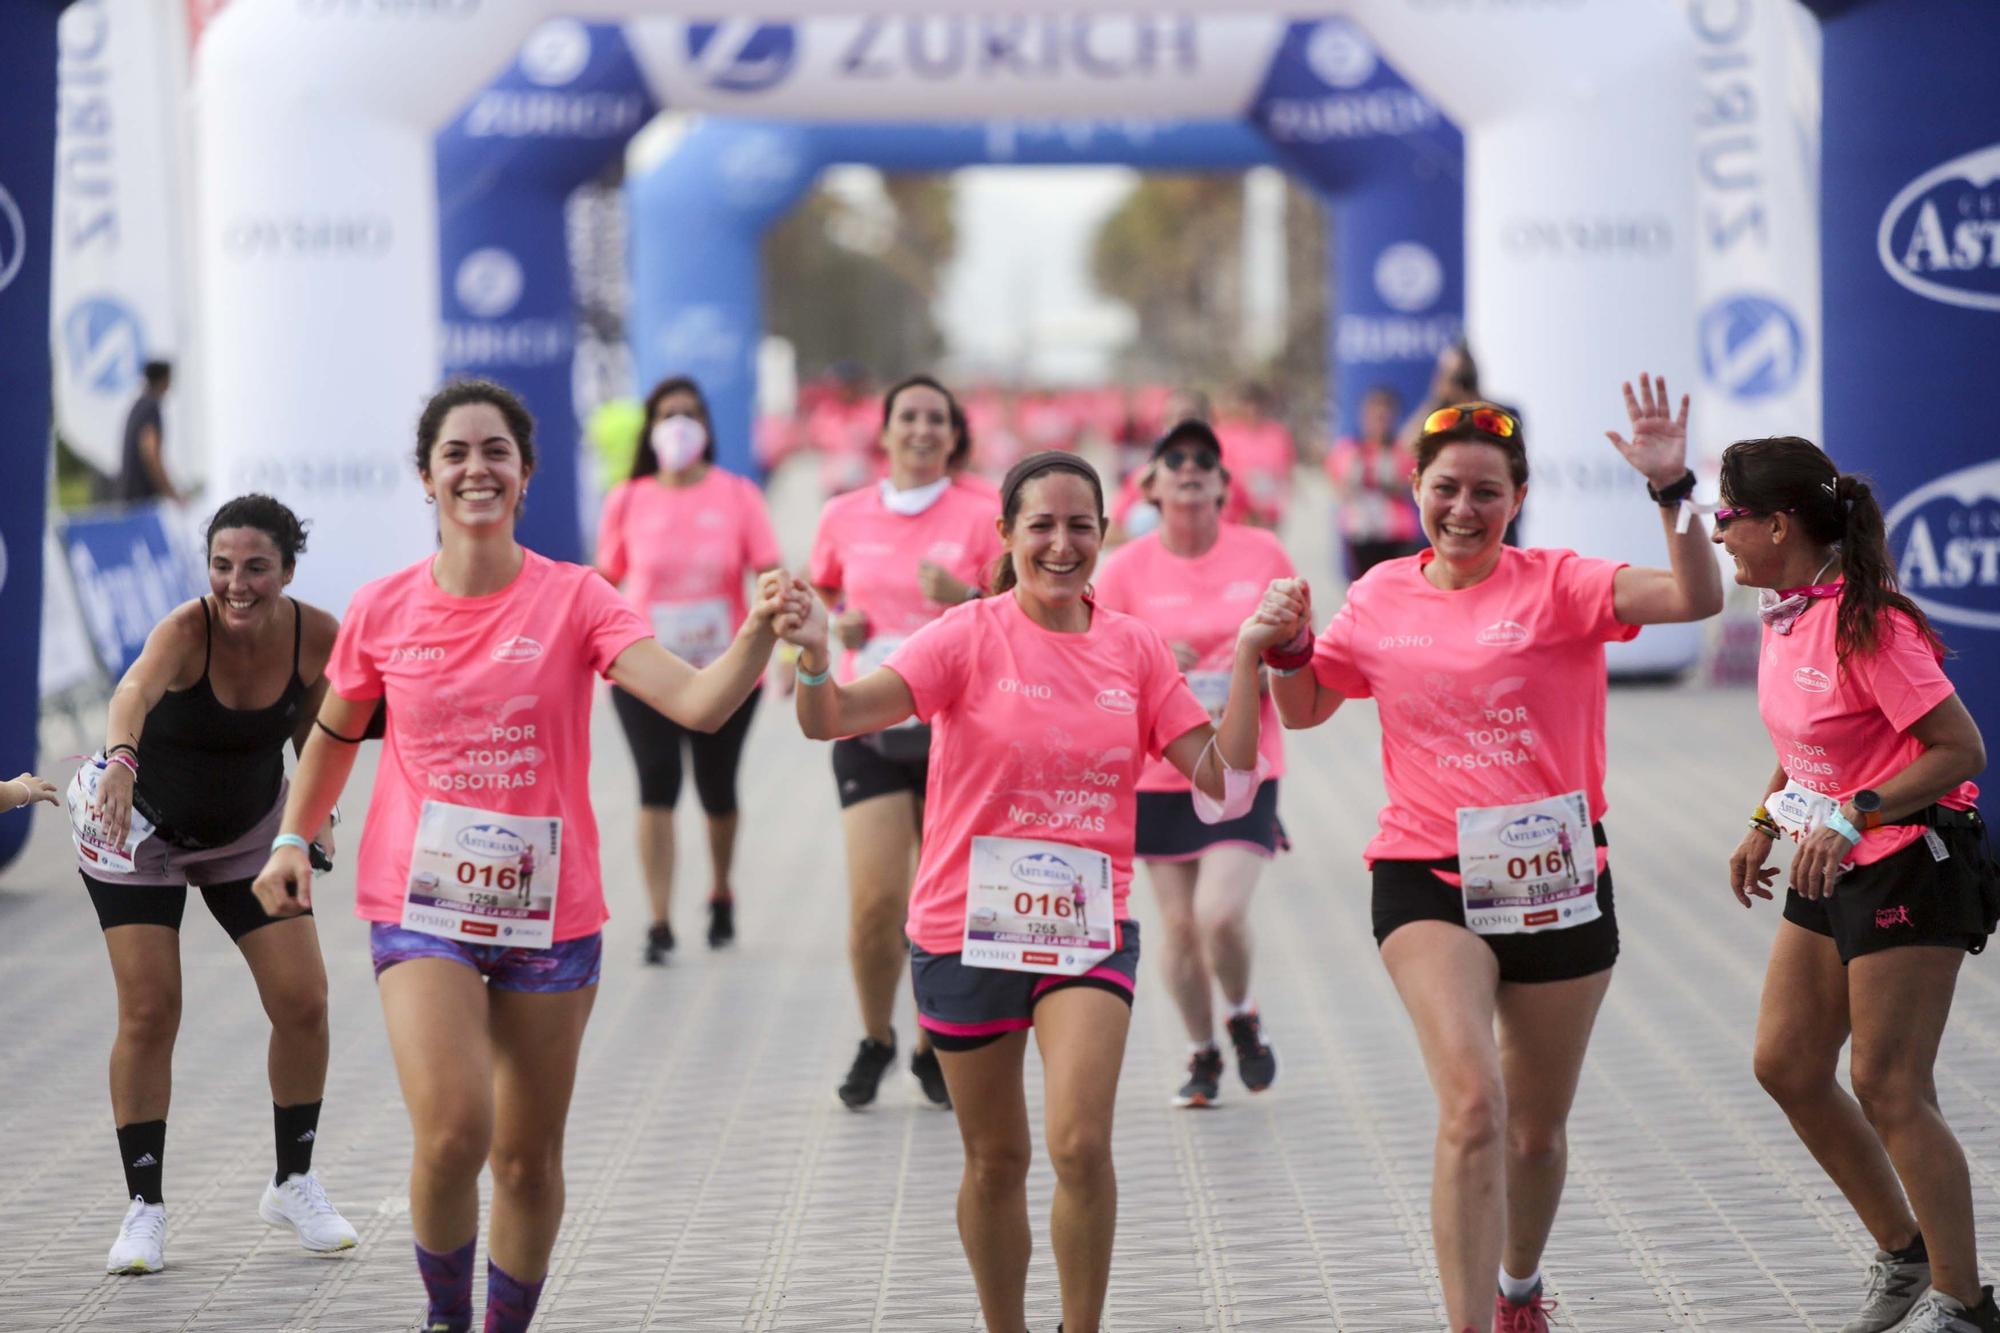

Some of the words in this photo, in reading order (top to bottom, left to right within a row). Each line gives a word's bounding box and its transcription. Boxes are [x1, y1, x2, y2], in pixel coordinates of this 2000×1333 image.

[840, 14, 1198, 79] ZURICH
[1379, 634, 1433, 650] OYSHO
[1484, 706, 1528, 724] POR
[491, 725, 536, 742] POR
[465, 746, 536, 766] TODAS
[1794, 740, 1827, 756] POR
[1786, 755, 1833, 775] TODAS
[428, 770, 536, 790] NOSOTRAS
[1082, 771, 1120, 787] POR
[1055, 789, 1111, 808] TODAS
[1008, 804, 1105, 832] NOSOTRAS
[1506, 850, 1562, 880] 016
[457, 861, 517, 890] 016
[1528, 883, 1550, 896] 510
[468, 892, 499, 906] 1258
[1013, 892, 1072, 918] 016
[487, 906, 499, 916] LA
[409, 911, 456, 929] OYSHO
[1027, 922, 1058, 935] 1265
[1471, 915, 1519, 928] OYSHO
[1046, 935, 1059, 945] LA
[969, 947, 1017, 962] OYSHO
